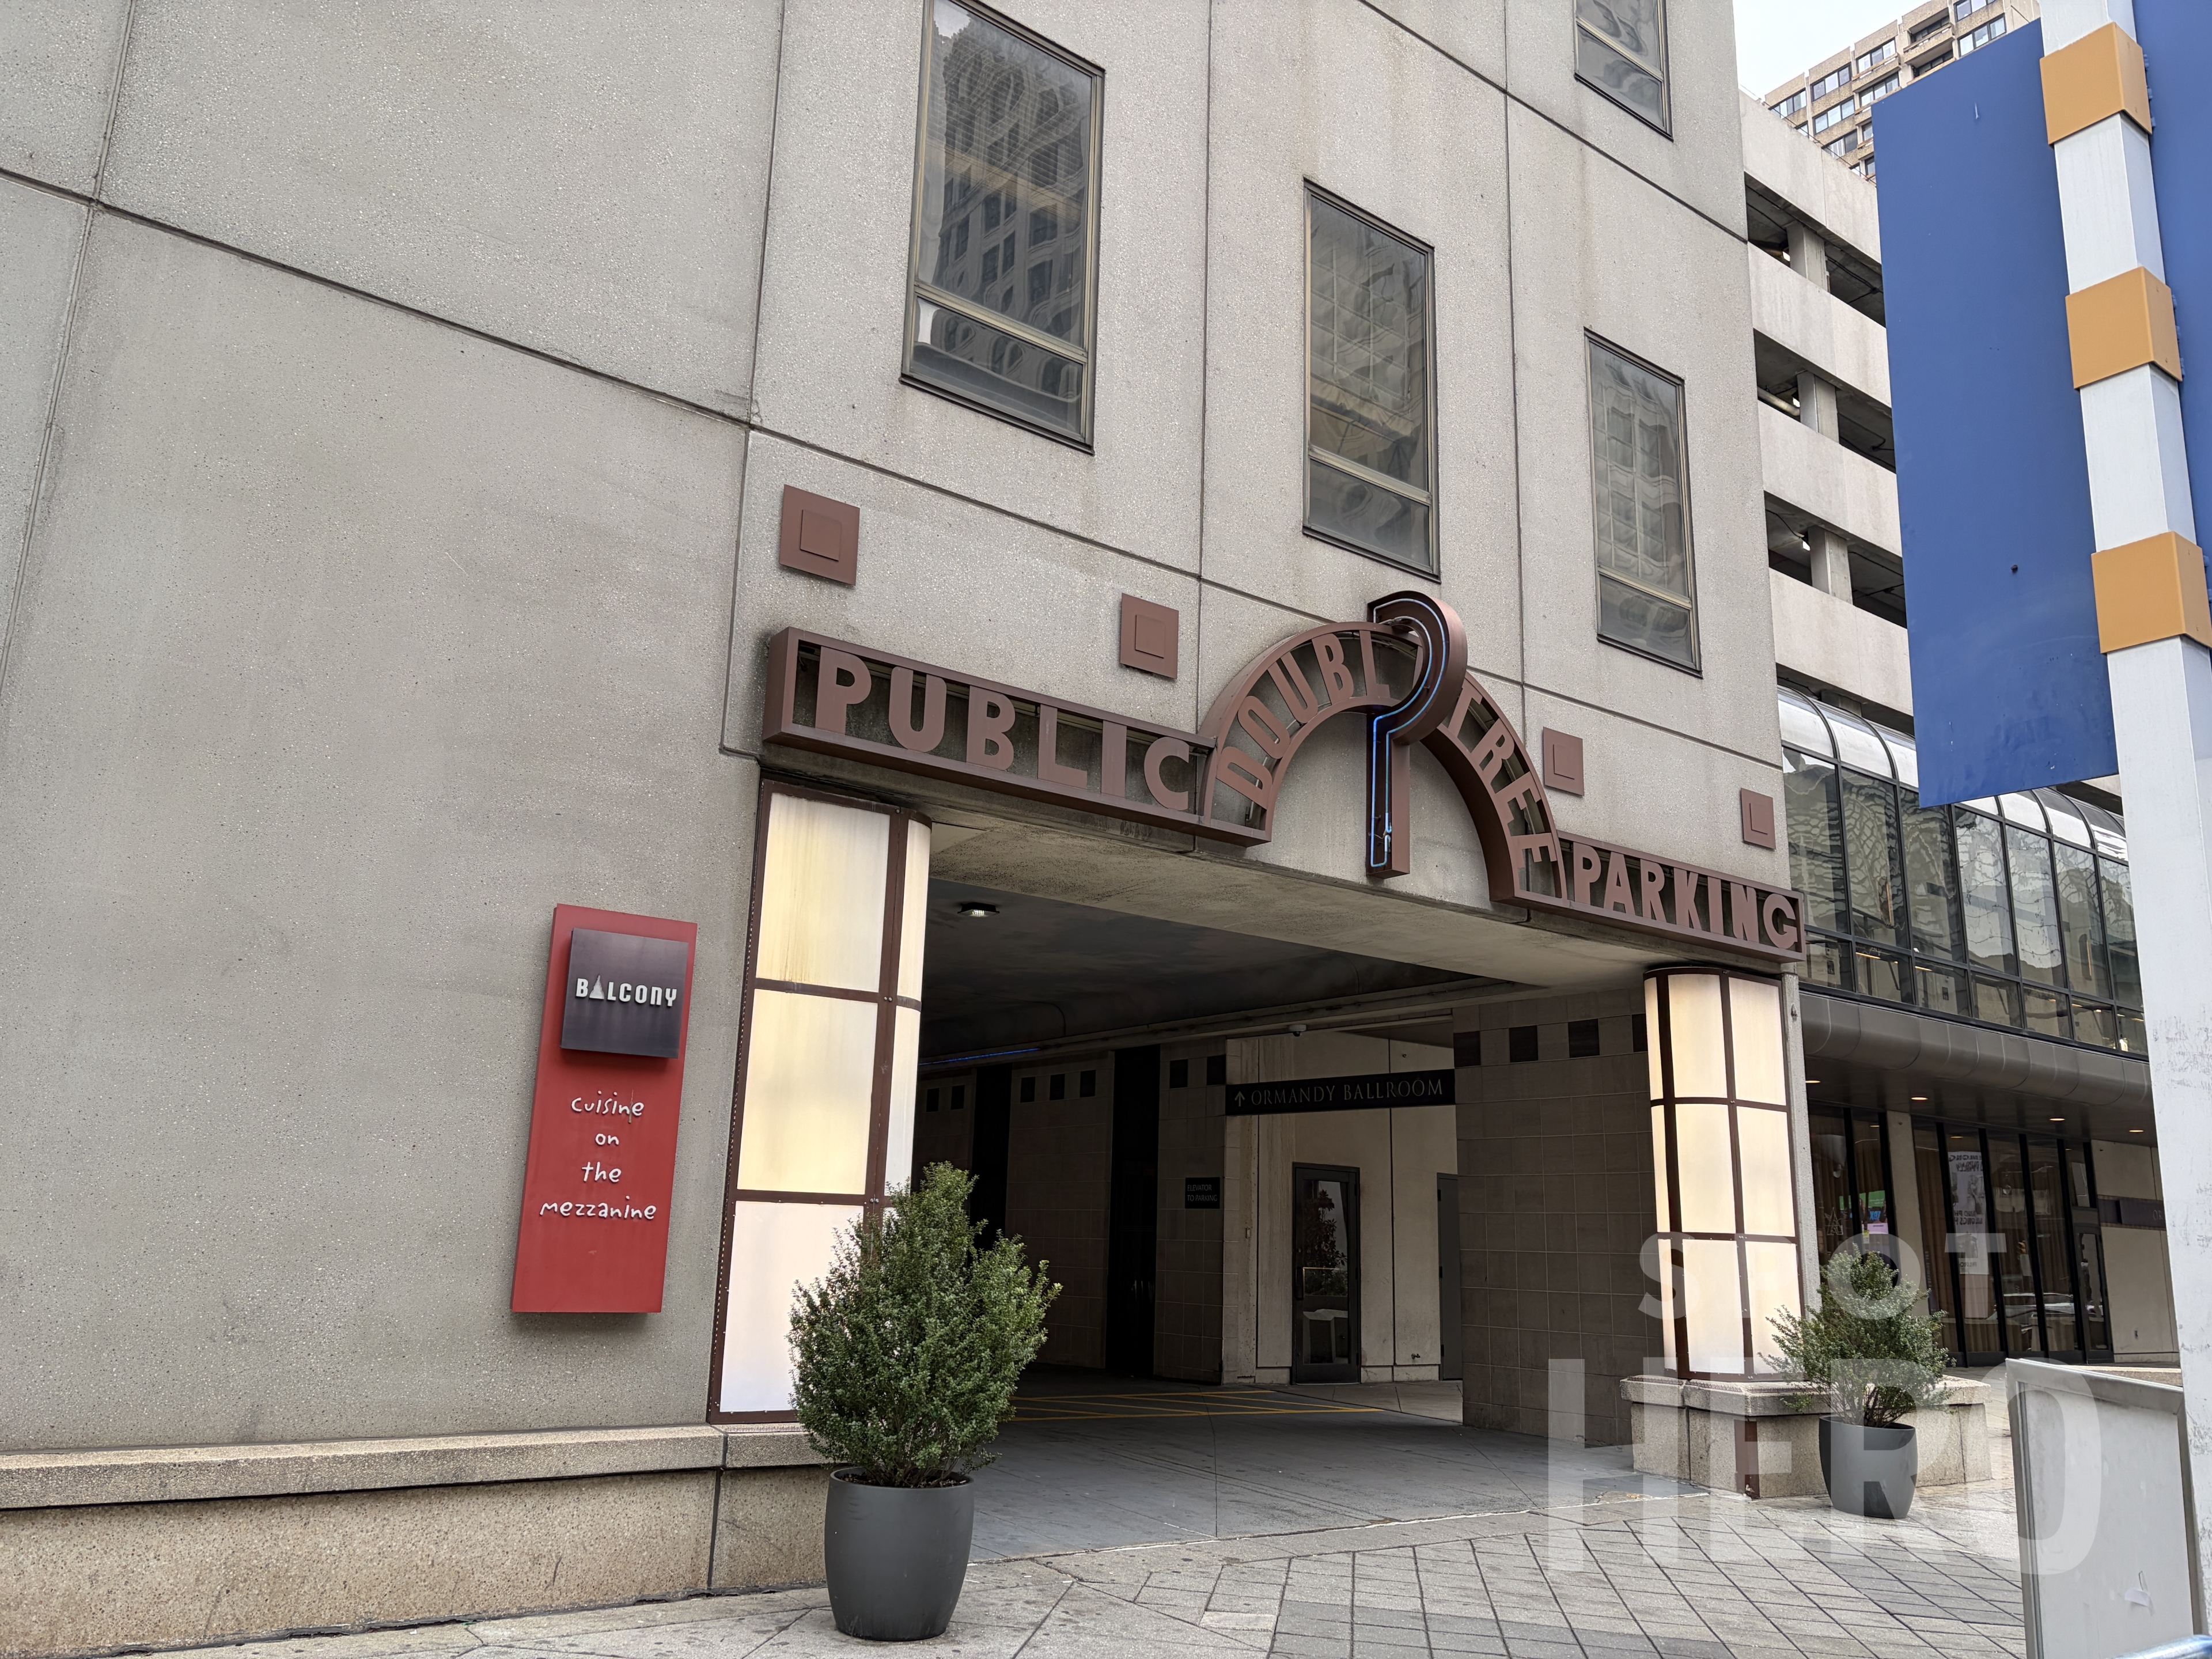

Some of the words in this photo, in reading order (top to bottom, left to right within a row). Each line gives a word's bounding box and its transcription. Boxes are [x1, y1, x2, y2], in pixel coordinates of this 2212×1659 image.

[815, 645, 1190, 810] PUBLIC
[1573, 842, 1798, 949] PARKING
[1251, 1085, 1335, 1105] ORMANDY
[1344, 1078, 1444, 1101] BALLROOM
[595, 1132, 619, 1146] on
[582, 1162, 622, 1183] the
[540, 1196, 656, 1220] mezzanine
